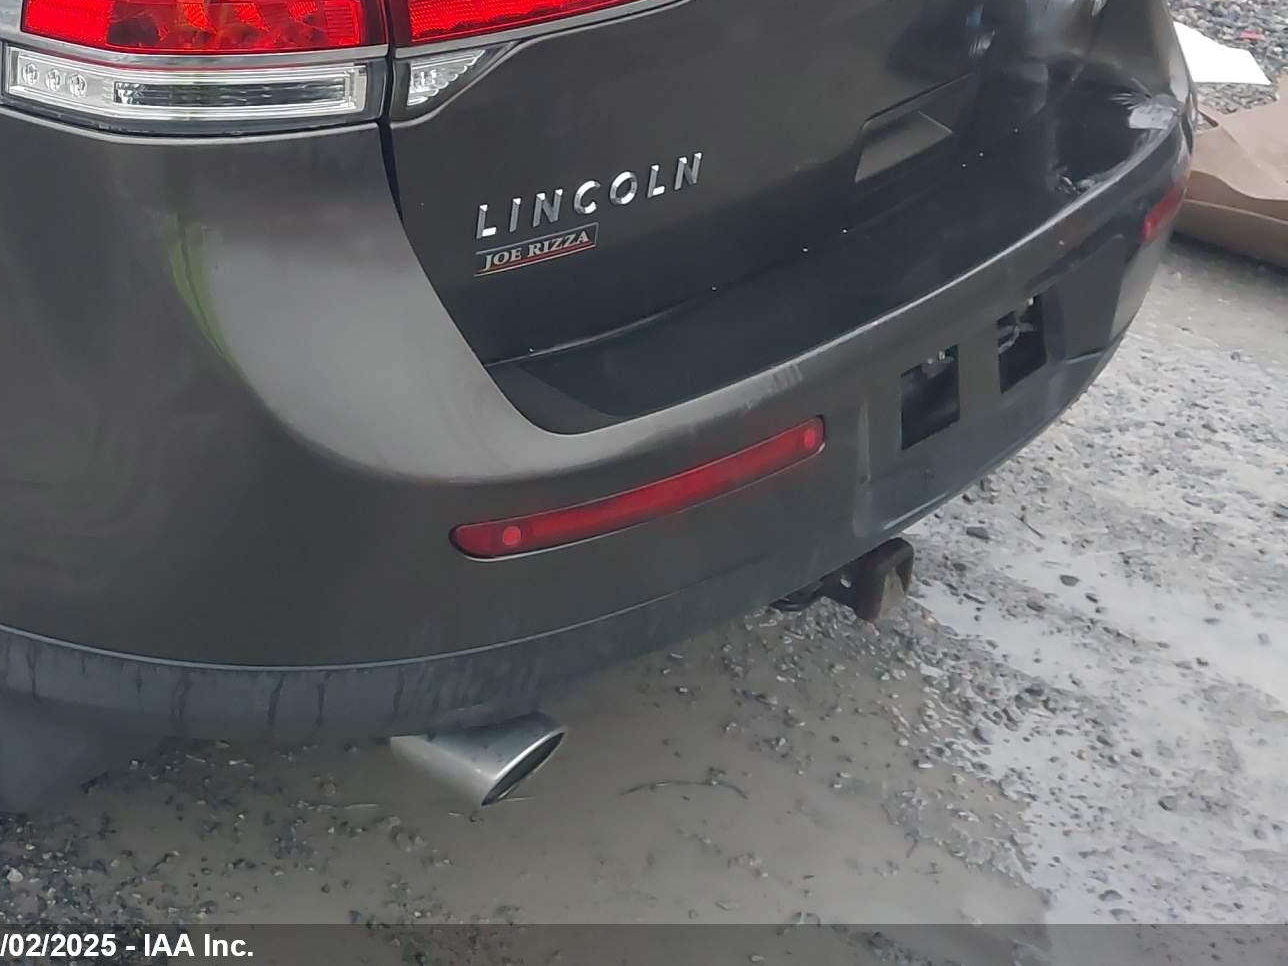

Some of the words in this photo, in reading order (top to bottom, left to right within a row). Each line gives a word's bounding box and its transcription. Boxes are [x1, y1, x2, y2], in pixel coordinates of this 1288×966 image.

[476, 152, 704, 239] LINCOLN
[483, 246, 522, 271] JOE
[527, 231, 590, 258] RIZZA
